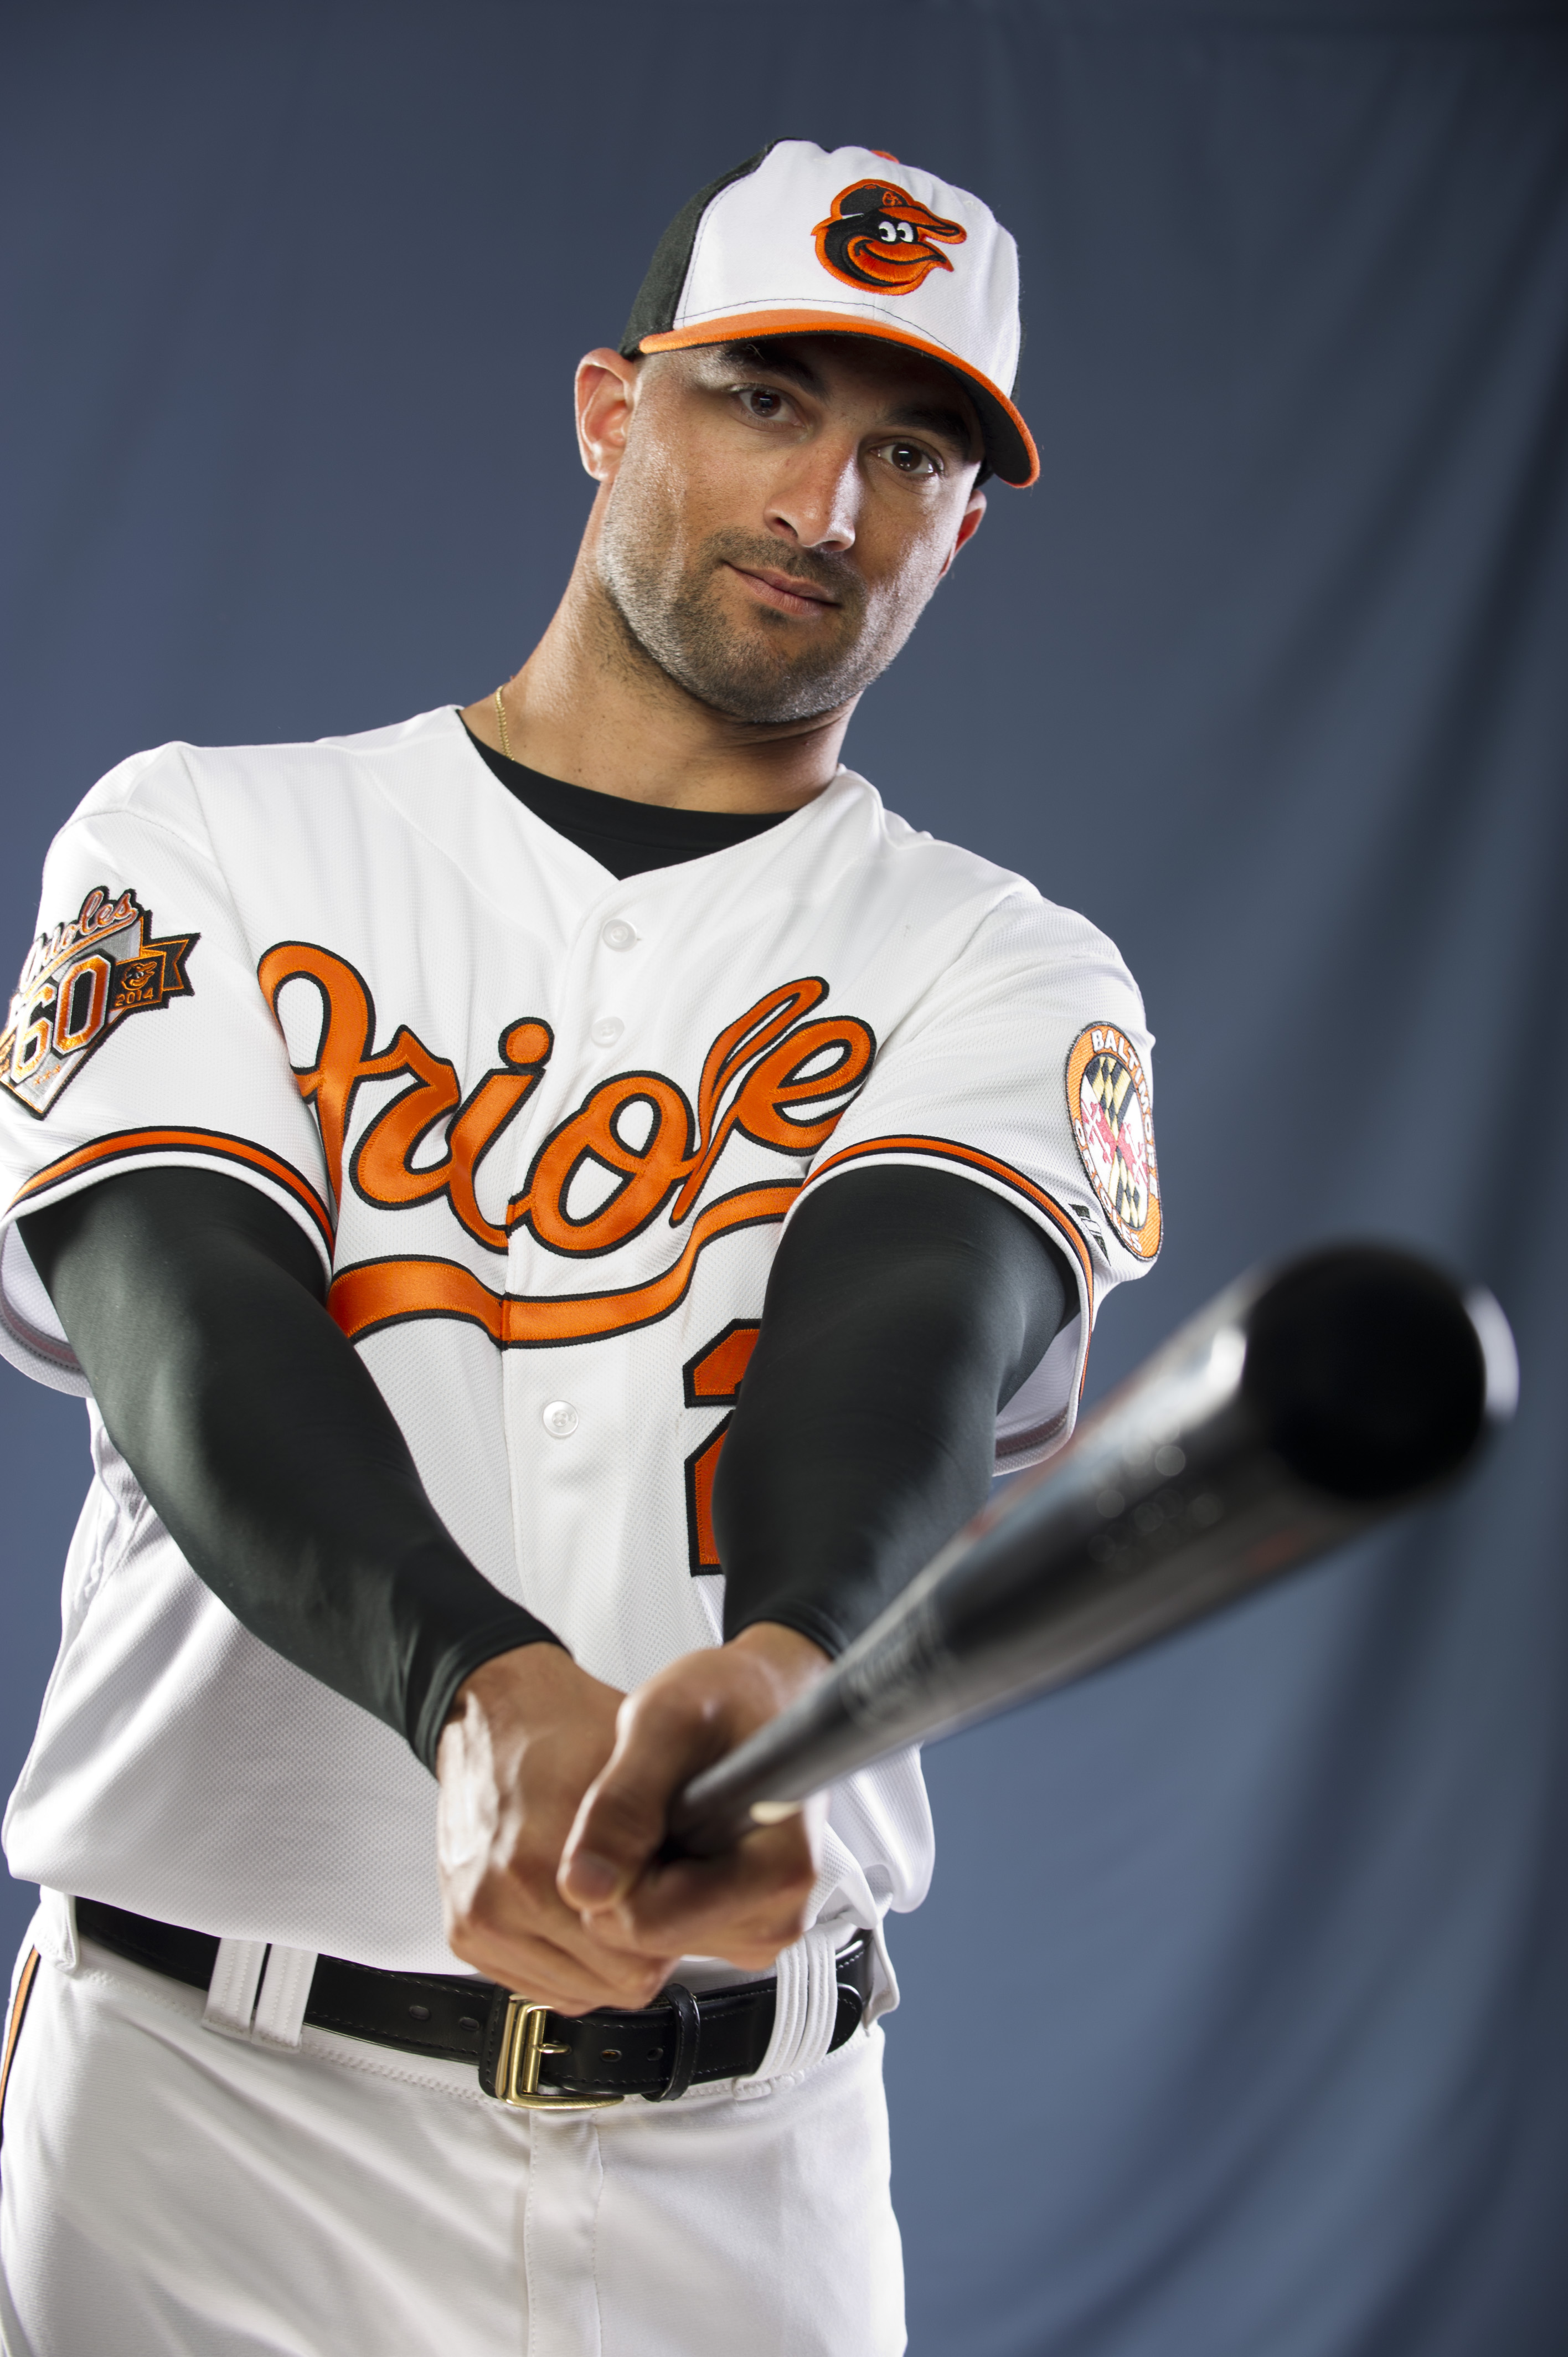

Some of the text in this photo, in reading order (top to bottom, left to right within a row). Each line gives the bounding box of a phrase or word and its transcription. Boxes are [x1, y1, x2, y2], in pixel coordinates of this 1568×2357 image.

[10, 954, 111, 1084] 60
[114, 987, 154, 1007] 2014
[257, 939, 877, 1257] Oriole
